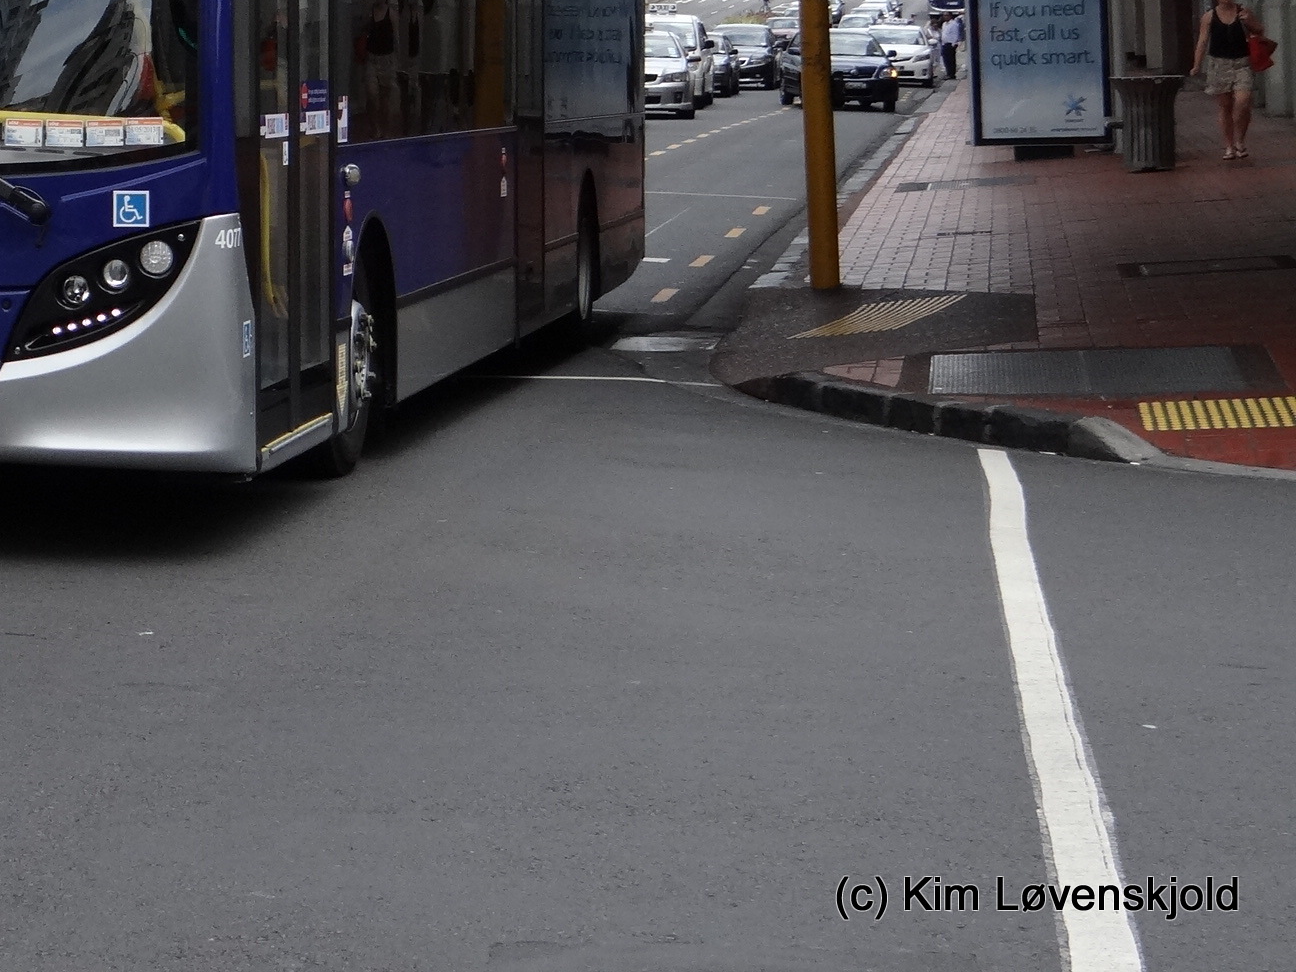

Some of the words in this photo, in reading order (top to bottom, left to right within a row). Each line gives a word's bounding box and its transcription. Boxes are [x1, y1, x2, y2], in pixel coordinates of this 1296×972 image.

[989, 1, 1001, 17] If
[1004, 4, 1036, 21] you
[1041, 0, 1086, 16] need
[990, 26, 1025, 43] fast,
[1028, 24, 1055, 41] call
[1060, 28, 1080, 40] us
[991, 49, 1037, 69] quick
[1041, 49, 1095, 65] smart.
